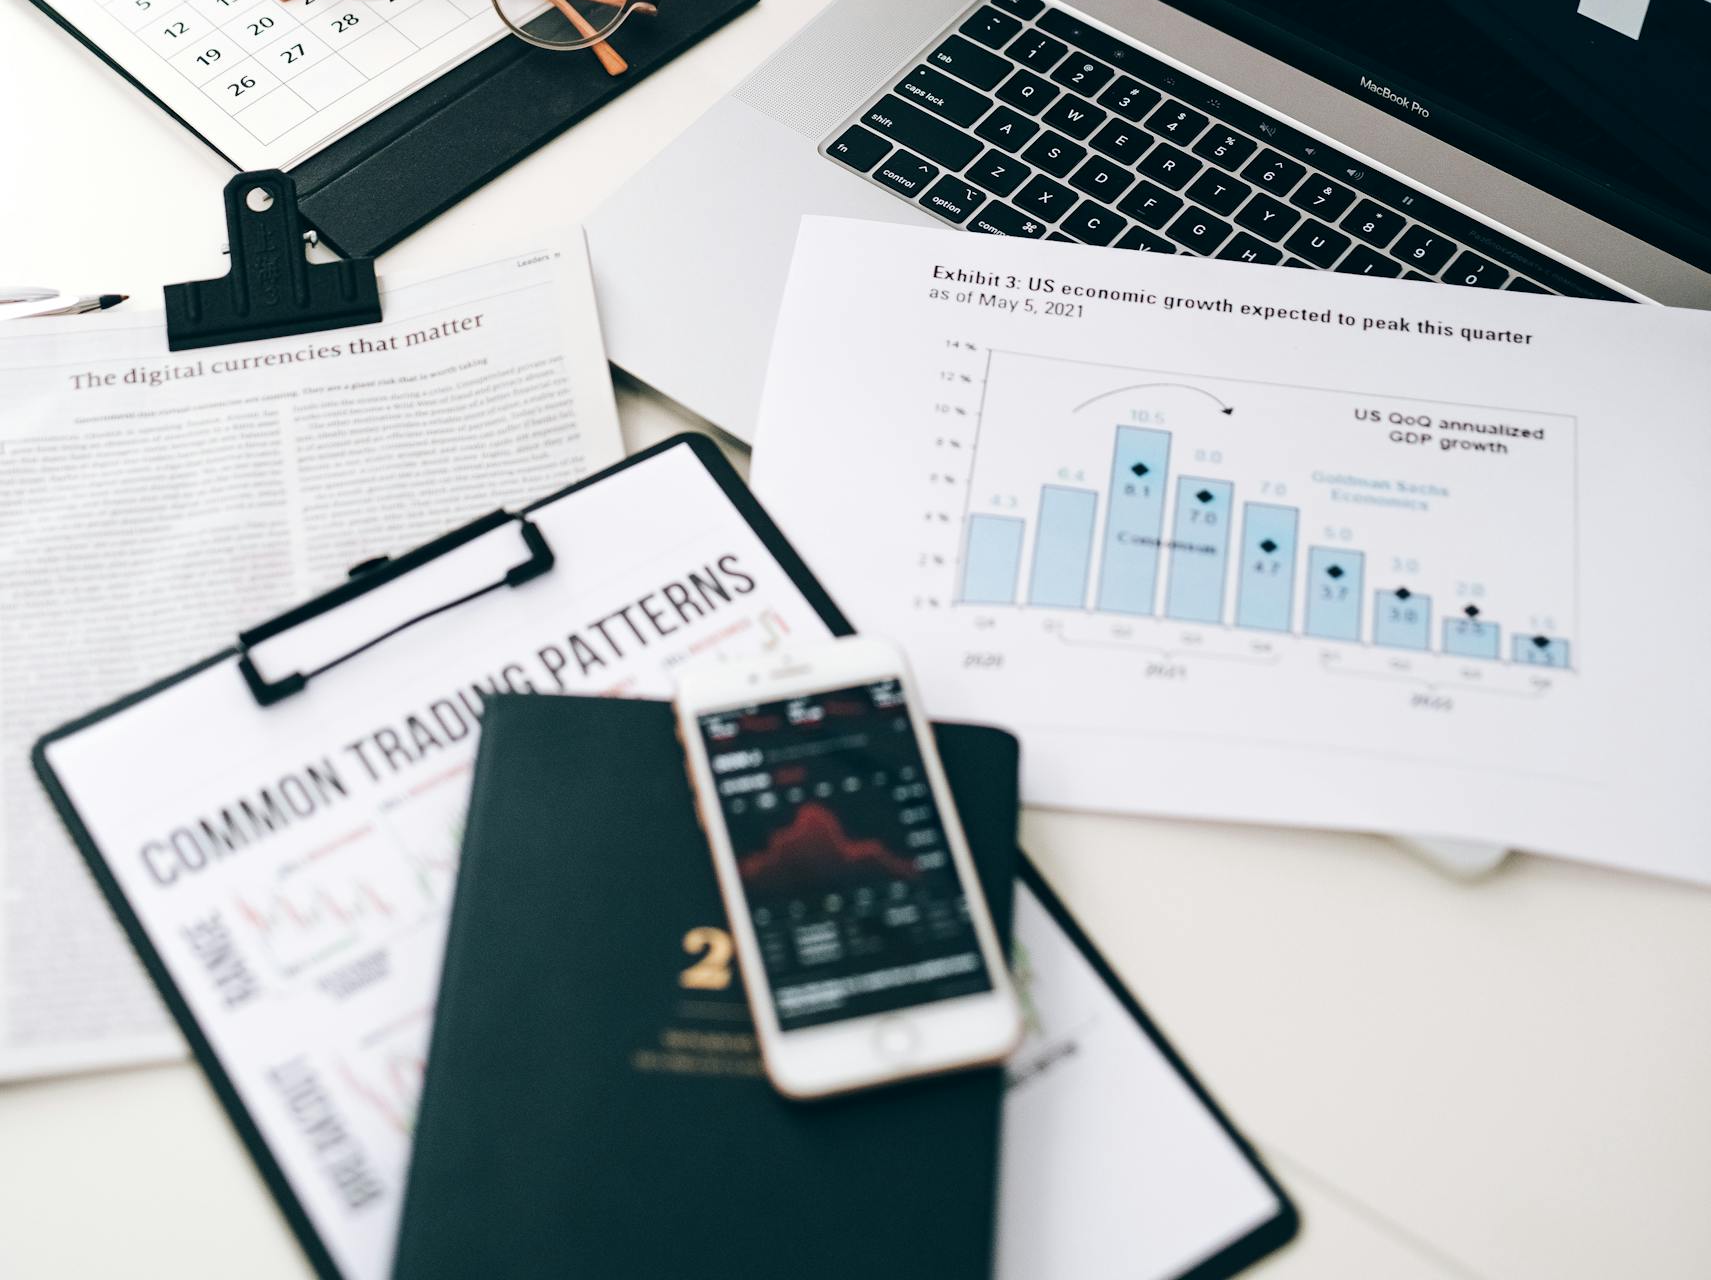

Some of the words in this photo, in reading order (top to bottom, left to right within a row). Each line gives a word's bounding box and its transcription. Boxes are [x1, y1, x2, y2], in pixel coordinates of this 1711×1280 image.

[163, 21, 190, 39] 12
[196, 48, 222, 66] 19
[246, 16, 275, 36] 20
[226, 76, 257, 97] 26
[279, 43, 306, 64] 27
[330, 13, 360, 33] 28
[937, 51, 953, 65] tab
[1028, 49, 1037, 59] 1
[1072, 73, 1085, 84] 2
[905, 81, 925, 98] caps
[925, 90, 945, 107] lock
[1021, 86, 1034, 98] Q
[1360, 75, 1410, 108] MacBook
[1411, 101, 1430, 120] Pro
[1119, 97, 1131, 108] 3
[871, 112, 893, 128] shift
[1067, 109, 1084, 122] W
[1000, 123, 1013, 135] A
[1166, 122, 1178, 132] 4
[1115, 135, 1128, 147] E
[837, 142, 849, 153] fn
[1048, 147, 1061, 159] S
[1214, 146, 1227, 157] 5
[1163, 160, 1176, 171] R
[990, 166, 1006, 178] Z
[1094, 172, 1108, 184] D
[1263, 171, 1275, 182] 6
[883, 167, 916, 190] control
[1215, 185, 1226, 196] T
[1038, 191, 1053, 203] X
[1312, 196, 1325, 206] 7
[932, 194, 961, 216] option
[1144, 198, 1157, 209] F
[1263, 210, 1275, 222] Y
[1087, 218, 1100, 229] C
[1193, 224, 1206, 235] G
[1362, 222, 1375, 233] 8
[1311, 236, 1325, 248] U
[1242, 250, 1257, 262] H
[1414, 248, 1426, 259] 9
[516, 254, 550, 268] Leaders
[929, 288, 952, 300] as
[955, 290, 974, 305] of
[978, 293, 1018, 313] May
[1024, 299, 1038, 316] 5,
[1044, 301, 1084, 319] 2021
[933, 264, 1000, 288] Exhibit
[1005, 275, 1021, 290] 3:
[1028, 277, 1055, 293] US
[1061, 283, 1158, 305] economic
[1163, 295, 1233, 314] growth
[1240, 301, 1332, 325] expected
[1338, 312, 1356, 327] to
[1362, 315, 1410, 333] peak
[1417, 320, 1454, 337] this
[1460, 325, 1534, 345] quarter
[70, 372, 117, 391] The
[123, 361, 204, 387] digital
[211, 343, 342, 375] currencies
[348, 334, 399, 356] that
[404, 312, 486, 347] matter
[1354, 408, 1382, 422] US
[1388, 412, 1432, 428] QoQ
[1438, 418, 1545, 441] annualized
[1388, 431, 1433, 446] GDP
[1440, 435, 1509, 455] growth
[1311, 470, 1391, 492] Goldman
[1396, 479, 1449, 498] Sachs
[1331, 489, 1430, 512] Economics
[139, 745, 349, 889] COMMON
[537, 554, 756, 692] PATTERNS
